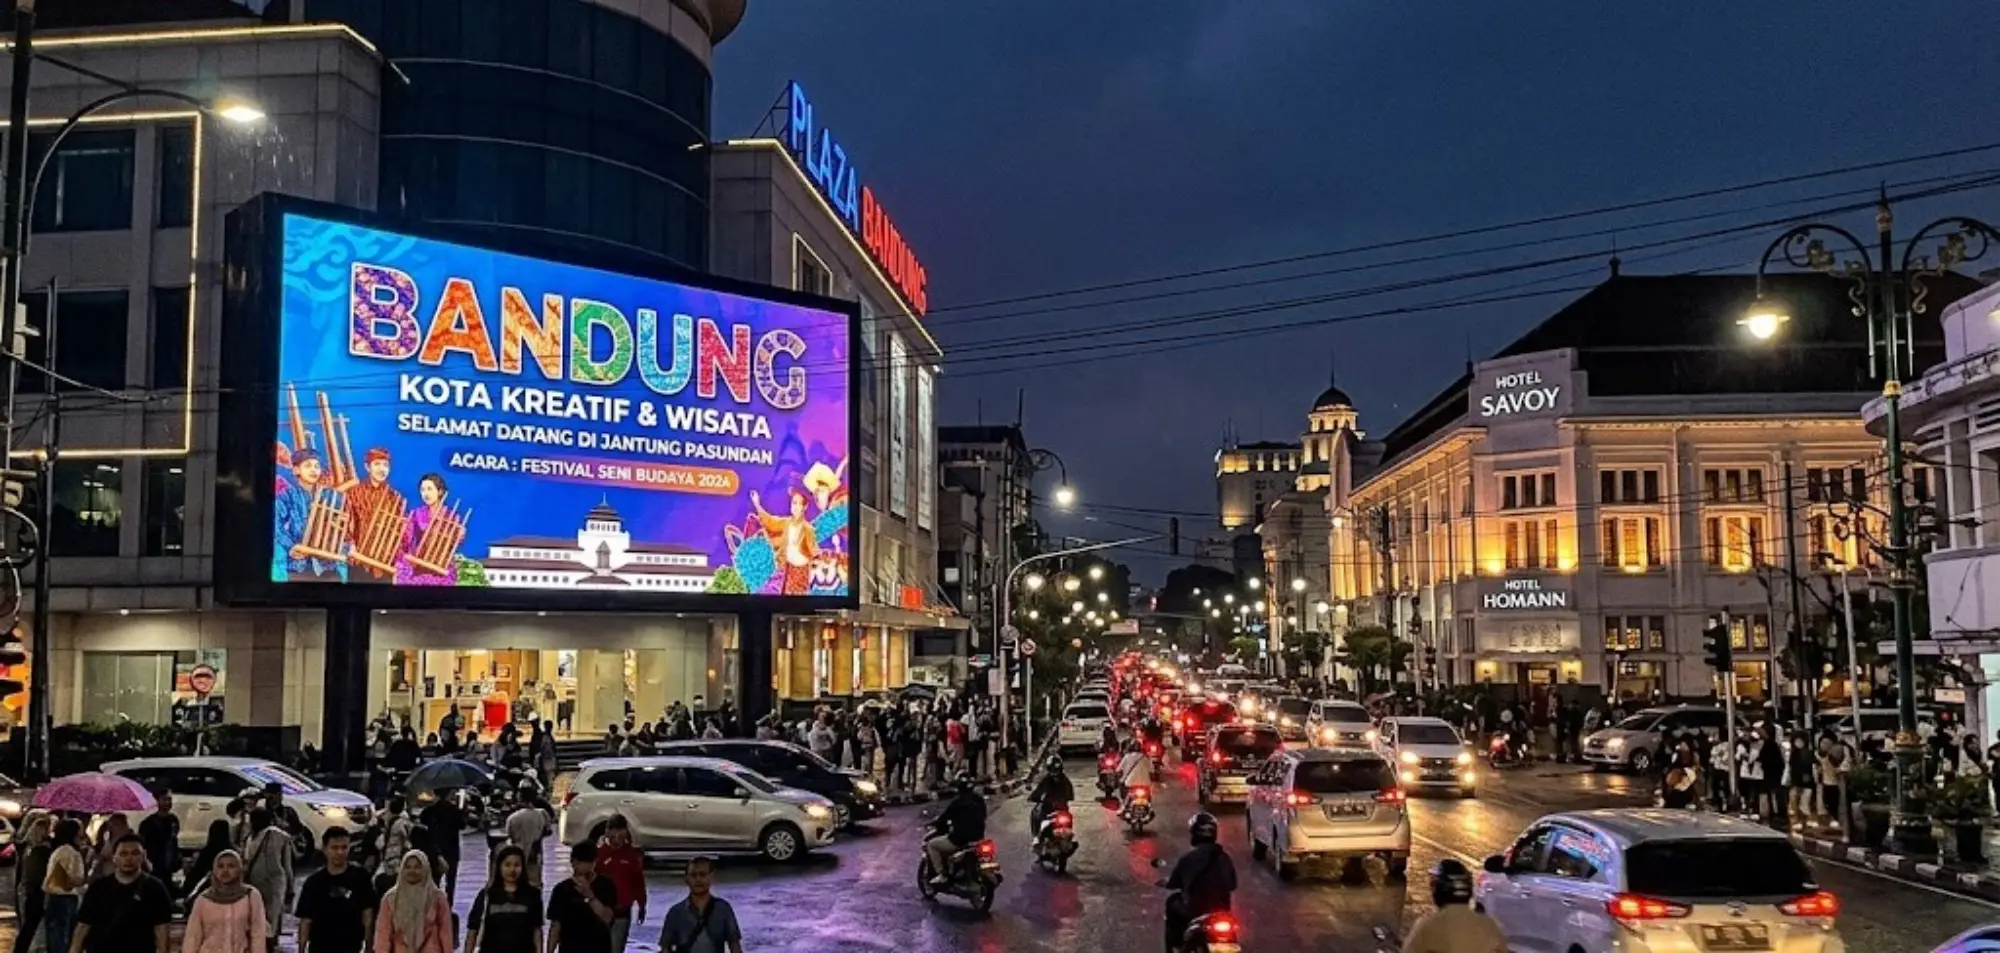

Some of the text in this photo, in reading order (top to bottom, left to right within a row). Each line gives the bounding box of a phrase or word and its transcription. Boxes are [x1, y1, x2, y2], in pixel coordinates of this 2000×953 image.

[790, 80, 859, 232] PLAZA
[862, 185, 927, 317] BANDUNG
[349, 262, 807, 410] BANDUNG
[1495, 371, 1542, 389] HOTEL
[399, 374, 773, 440] KOTA KREATIF & WISATA
[1481, 386, 1560, 417] SAVOY
[397, 413, 773, 465] SELAMAT DATANG DI JANTUNG PASUNDAN
[449, 452, 510, 471] ACARA
[521, 458, 595, 480] FESTIVAL
[598, 464, 632, 482] SENI
[635, 467, 696, 486] BUDAYA
[1483, 591, 1566, 609] HOMANN
[1504, 580, 1541, 590] HOTEL
